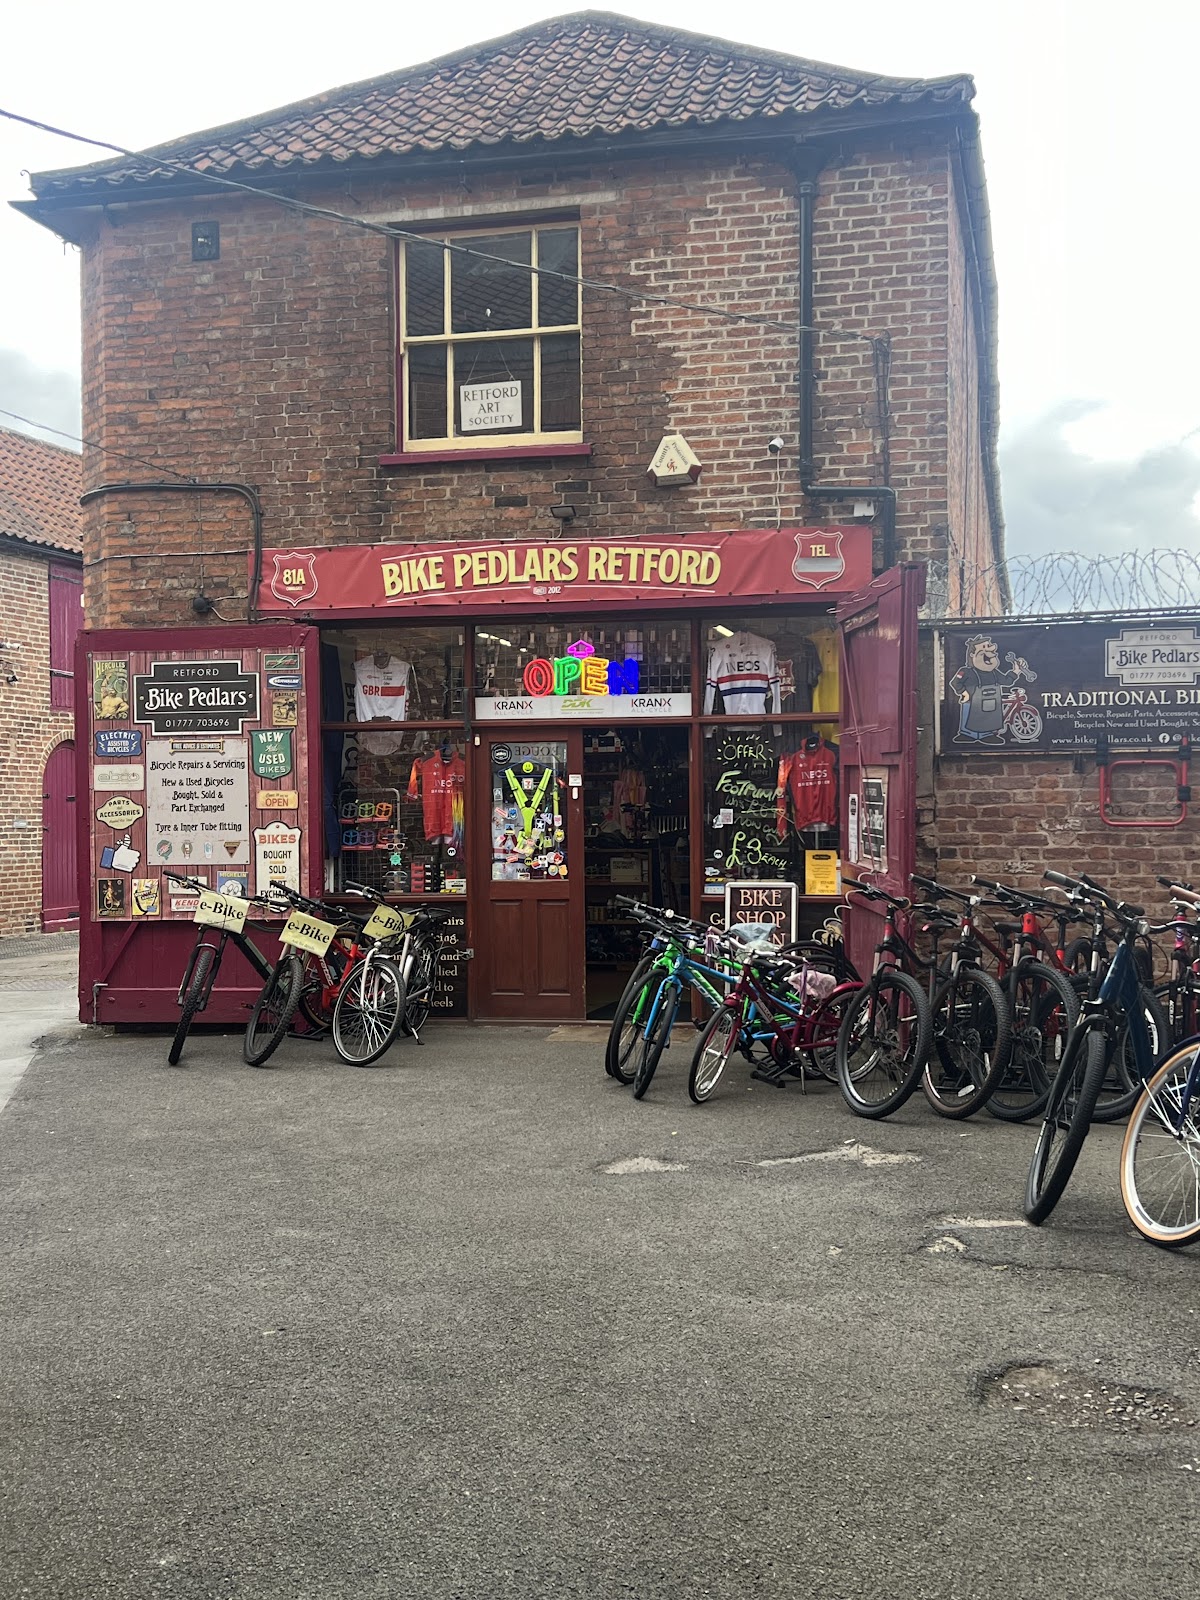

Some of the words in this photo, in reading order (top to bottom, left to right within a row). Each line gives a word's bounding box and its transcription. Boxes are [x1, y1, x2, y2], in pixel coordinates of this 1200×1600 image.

[464, 387, 518, 401] RETFORD
[478, 402, 500, 414] ART
[469, 414, 514, 426] SOCIETY
[283, 569, 306, 585] 81A
[381, 556, 446, 597] BIKE
[453, 547, 579, 588] PEDLARS
[587, 547, 721, 586] RETFORD
[547, 586, 561, 594] 2012
[1116, 649, 1147, 666] Bike
[1152, 649, 1200, 663] Pedlars
[726, 660, 760, 673] INEOS
[173, 668, 219, 677] RETFORD
[523, 656, 638, 697] OPEN
[362, 685, 380, 696] GBR
[145, 688, 183, 710] Bike
[188, 687, 247, 706] Pedlars
[631, 697, 671, 707] KRANX
[1041, 690, 1171, 707] TRADITIONAL
[494, 700, 533, 710] KRANX
[1046, 711, 1076, 720] Bicycle,
[1076, 710, 1105, 718] Service,
[165, 719, 193, 727] 01777
[196, 719, 230, 727] 703696
[1074, 720, 1105, 729] Bicycles
[1106, 719, 1124, 728] New
[1124, 719, 1139, 727] and
[1140, 719, 1159, 727] Used
[100, 732, 136, 741] ELECTRIC
[258, 732, 284, 744] NEW
[723, 744, 766, 760] OFFER
[258, 753, 286, 765] USED
[150, 761, 176, 770] Bicycle
[178, 760, 204, 770] Repairs
[213, 760, 246, 770] Servicing
[259, 765, 286, 774] BIKES
[801, 769, 828, 779] INEOS
[162, 778, 177, 787] New
[178, 778, 184, 786] &
[186, 777, 202, 786] Used
[204, 777, 234, 787] Bicycles
[201, 790, 215, 799] Sold
[217, 791, 223, 799] &
[171, 804, 187, 812] Part
[189, 803, 225, 813] Exchanged
[265, 798, 289, 807] OPEN
[99, 809, 141, 818] ACCESSORIES
[155, 823, 171, 833] Tyre
[173, 823, 178, 831] &
[180, 823, 198, 832] Inner
[200, 822, 217, 831] Tube
[219, 822, 242, 832] fitting
[258, 834, 296, 844] BIKES
[263, 850, 292, 859] BOUGHT
[761, 852, 787, 867] EACH
[269, 865, 287, 874] SOLD
[175, 899, 200, 907] KEND
[739, 889, 782, 906] BIKE
[199, 900, 244, 920] e-Bike
[373, 914, 408, 931] e-Bike
[736, 910, 786, 928] SHOP
[287, 919, 330, 944] e-Bike
[440, 949, 460, 960] and
[443, 983, 454, 991] to
